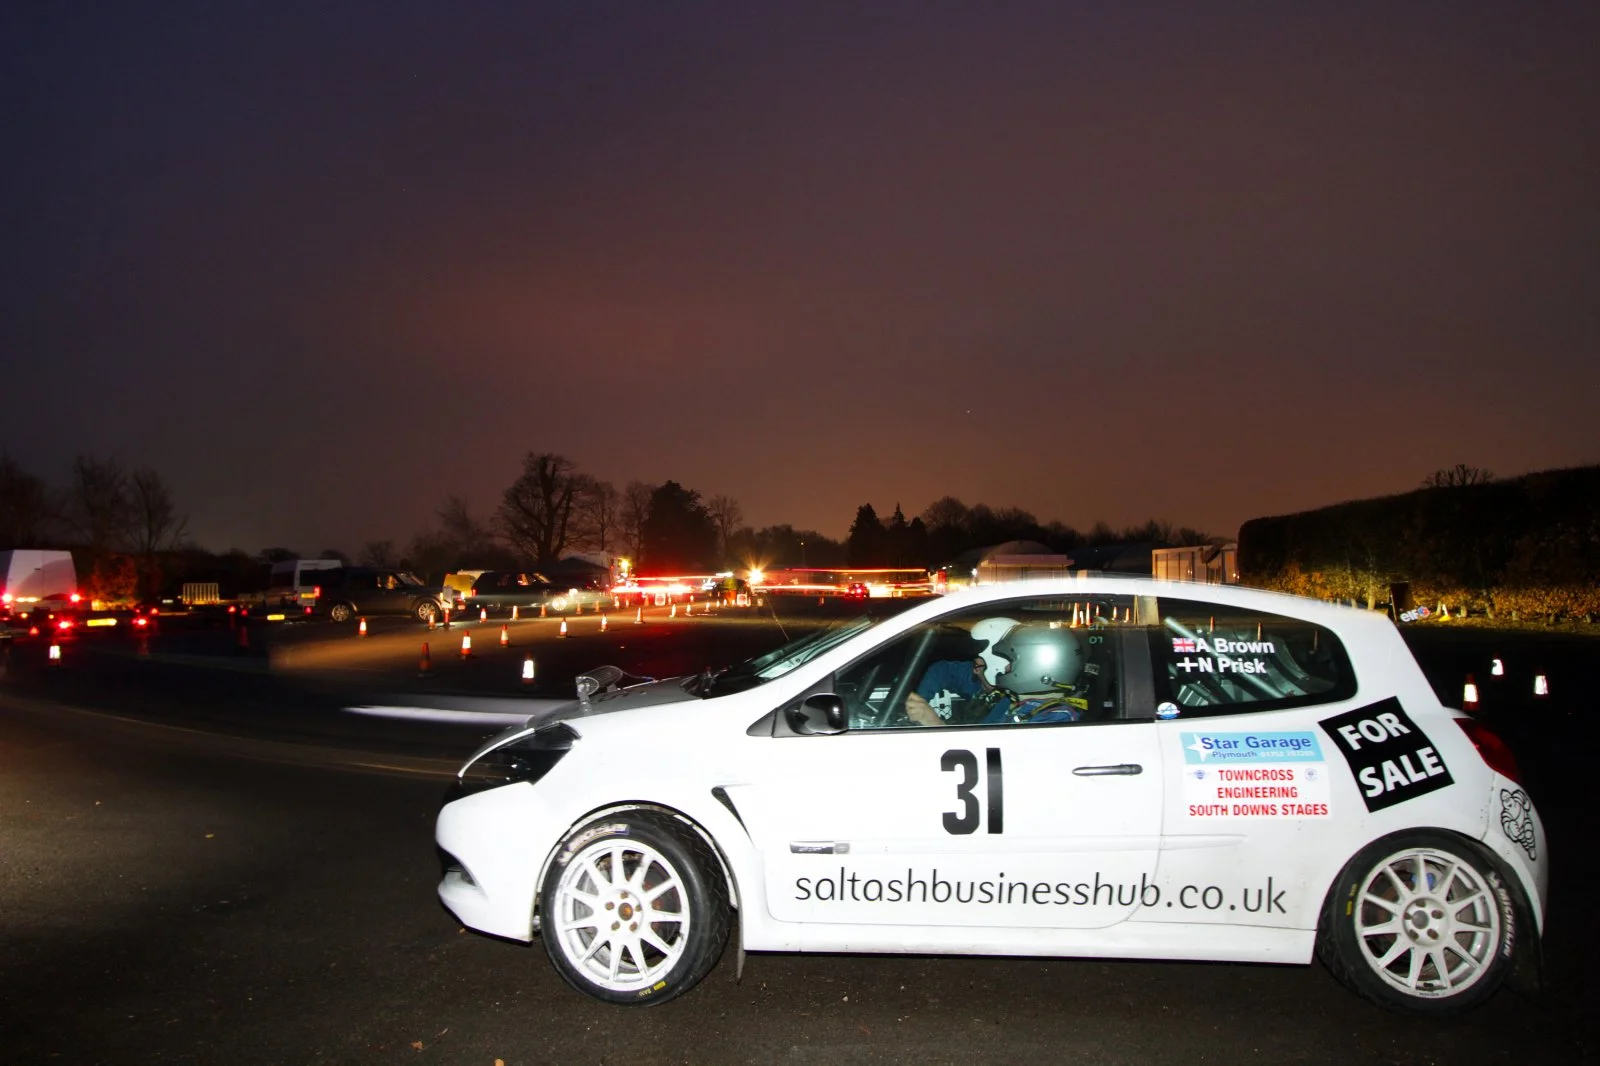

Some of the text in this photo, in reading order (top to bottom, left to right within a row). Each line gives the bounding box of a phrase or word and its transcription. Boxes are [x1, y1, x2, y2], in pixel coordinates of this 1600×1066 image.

[1196, 638, 1275, 653] A Brown
[1198, 657, 1267, 673] N Prisk
[1337, 712, 1411, 751] FOR
[1201, 736, 1312, 750] Star Garage
[1212, 750, 1257, 759] Plymouth
[1218, 769, 1294, 781] TOWNCROSS
[1358, 746, 1445, 798] SALE
[940, 747, 1003, 835] 31
[1217, 786, 1298, 799] ENGINEERING
[1189, 803, 1329, 817] SOUTH DOWNS STAGES
[795, 866, 1287, 914] saltashbusinesshub.co.uk
